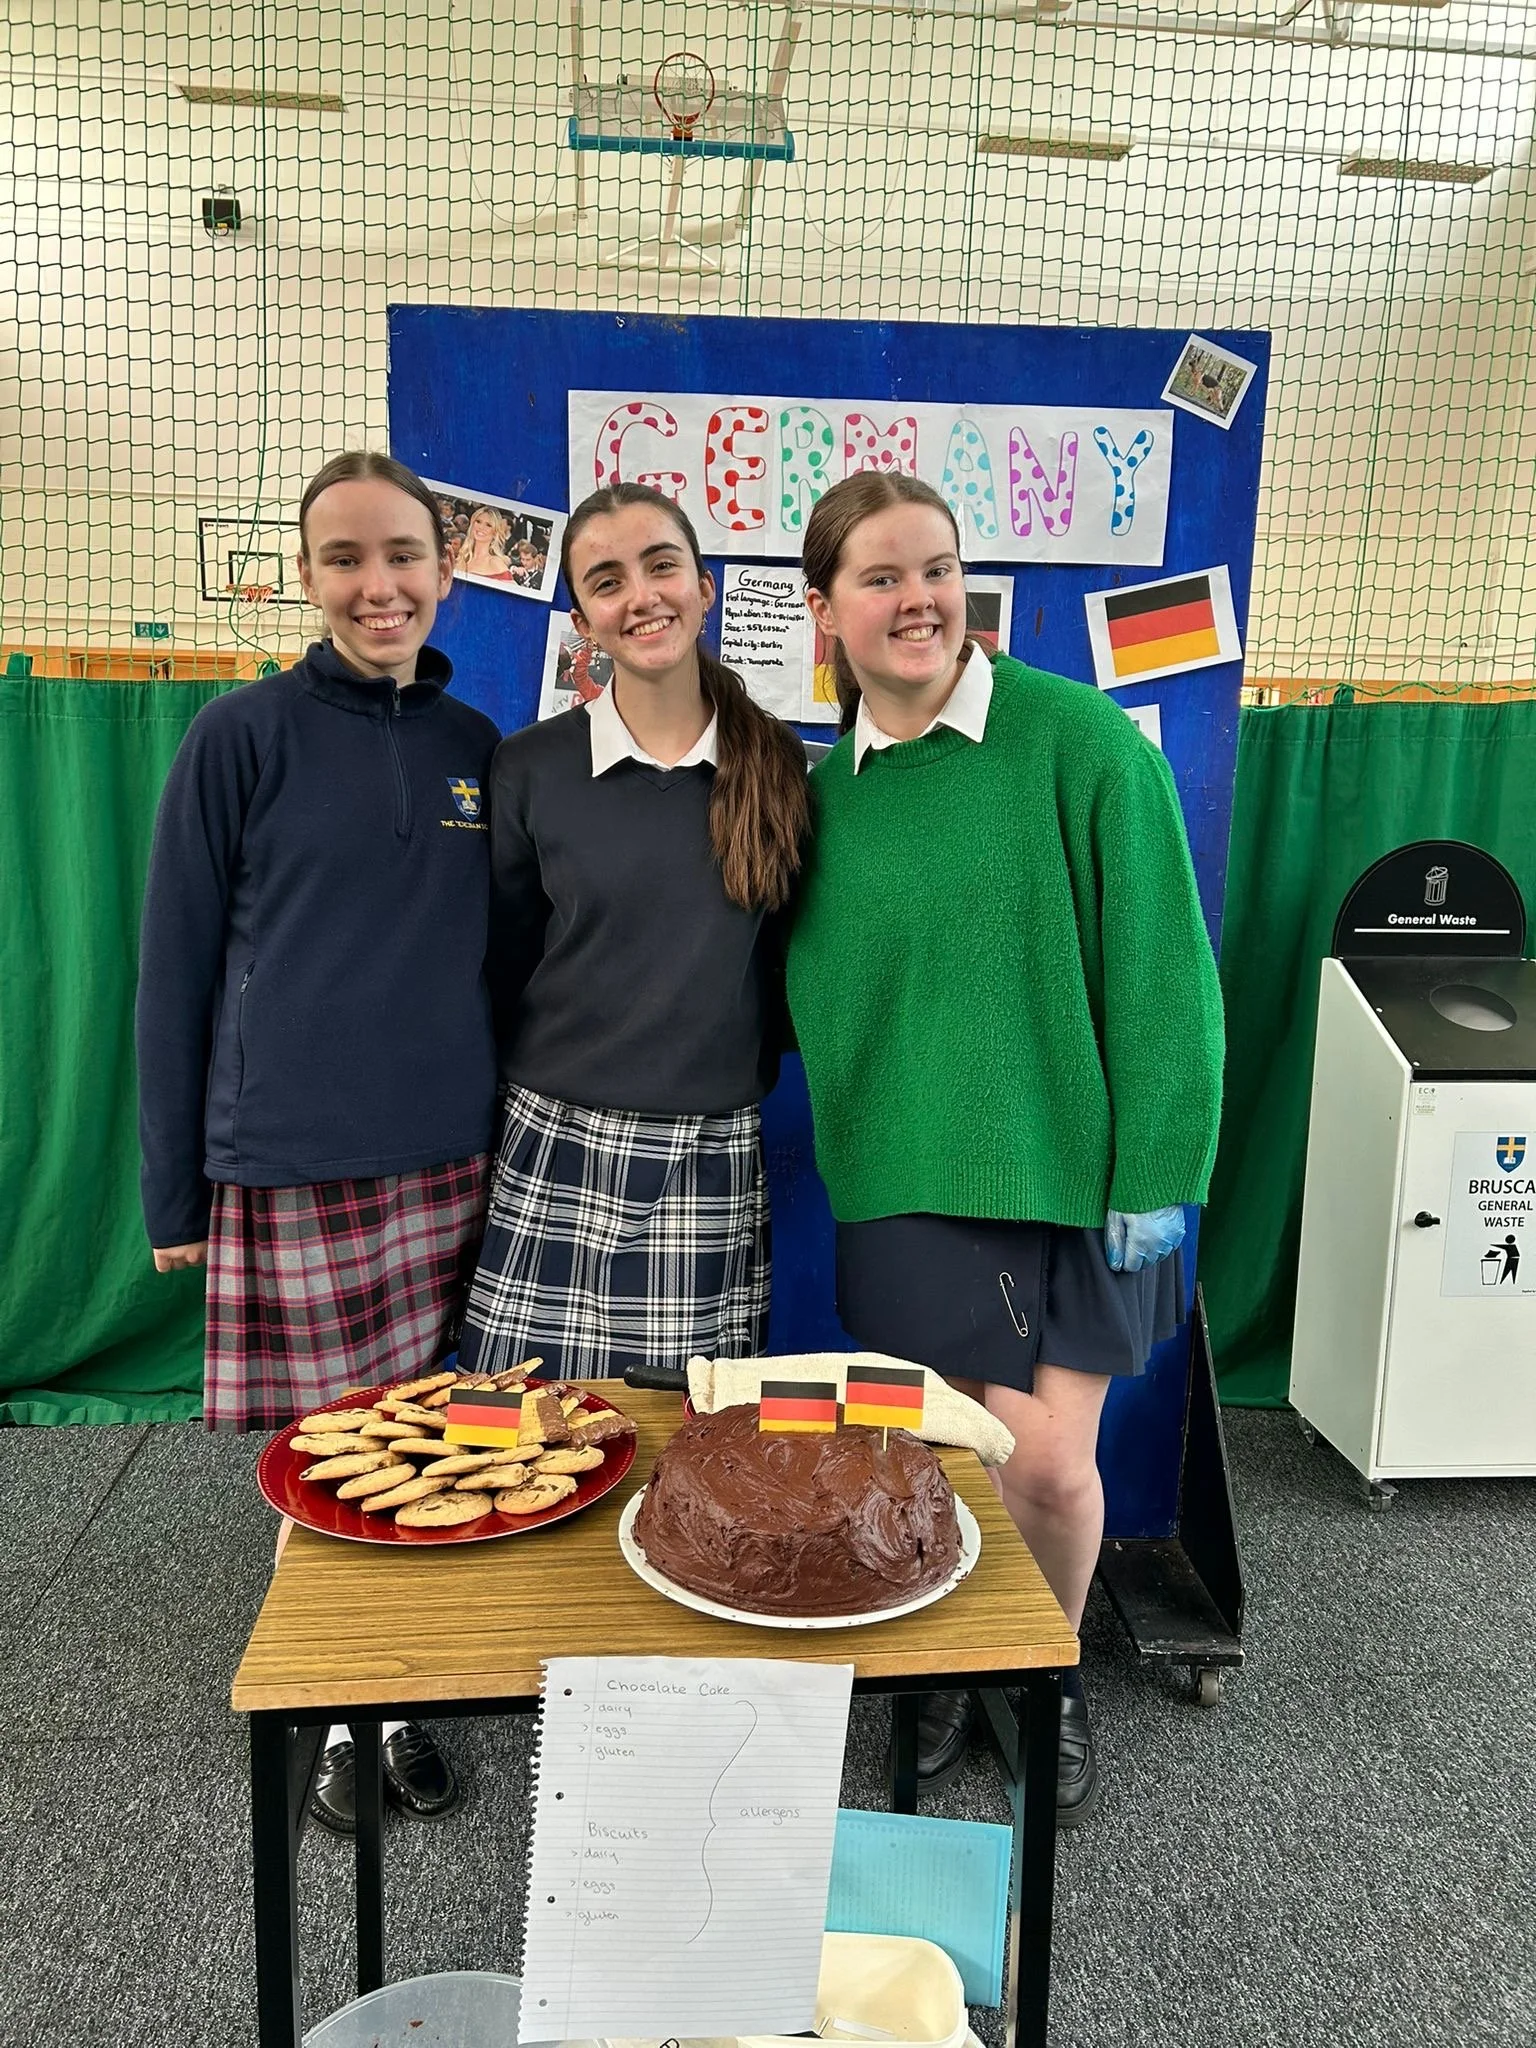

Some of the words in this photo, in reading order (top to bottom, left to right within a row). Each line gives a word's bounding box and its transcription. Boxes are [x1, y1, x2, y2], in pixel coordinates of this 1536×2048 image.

[594, 402, 1155, 540] GERMANY
[738, 569, 794, 592] Germany
[1388, 913, 1437, 925] General
[1439, 914, 1477, 926] Waste
[1468, 1179, 1536, 1195] BRUSCA
[1477, 1200, 1534, 1212] GENERAL
[1483, 1216, 1526, 1228] WASTE
[607, 1679, 687, 1695] Chocolate
[699, 1683, 731, 1697] Cake
[598, 1703, 632, 1719] dairy
[596, 1725, 627, 1739] eggs
[595, 1746, 636, 1761] gluten
[739, 1806, 800, 1826] allergens
[588, 1821, 649, 1840] Biscuits
[584, 1847, 620, 1865] dairy
[583, 1880, 616, 1895] eggs
[577, 1910, 620, 1927] gluten
